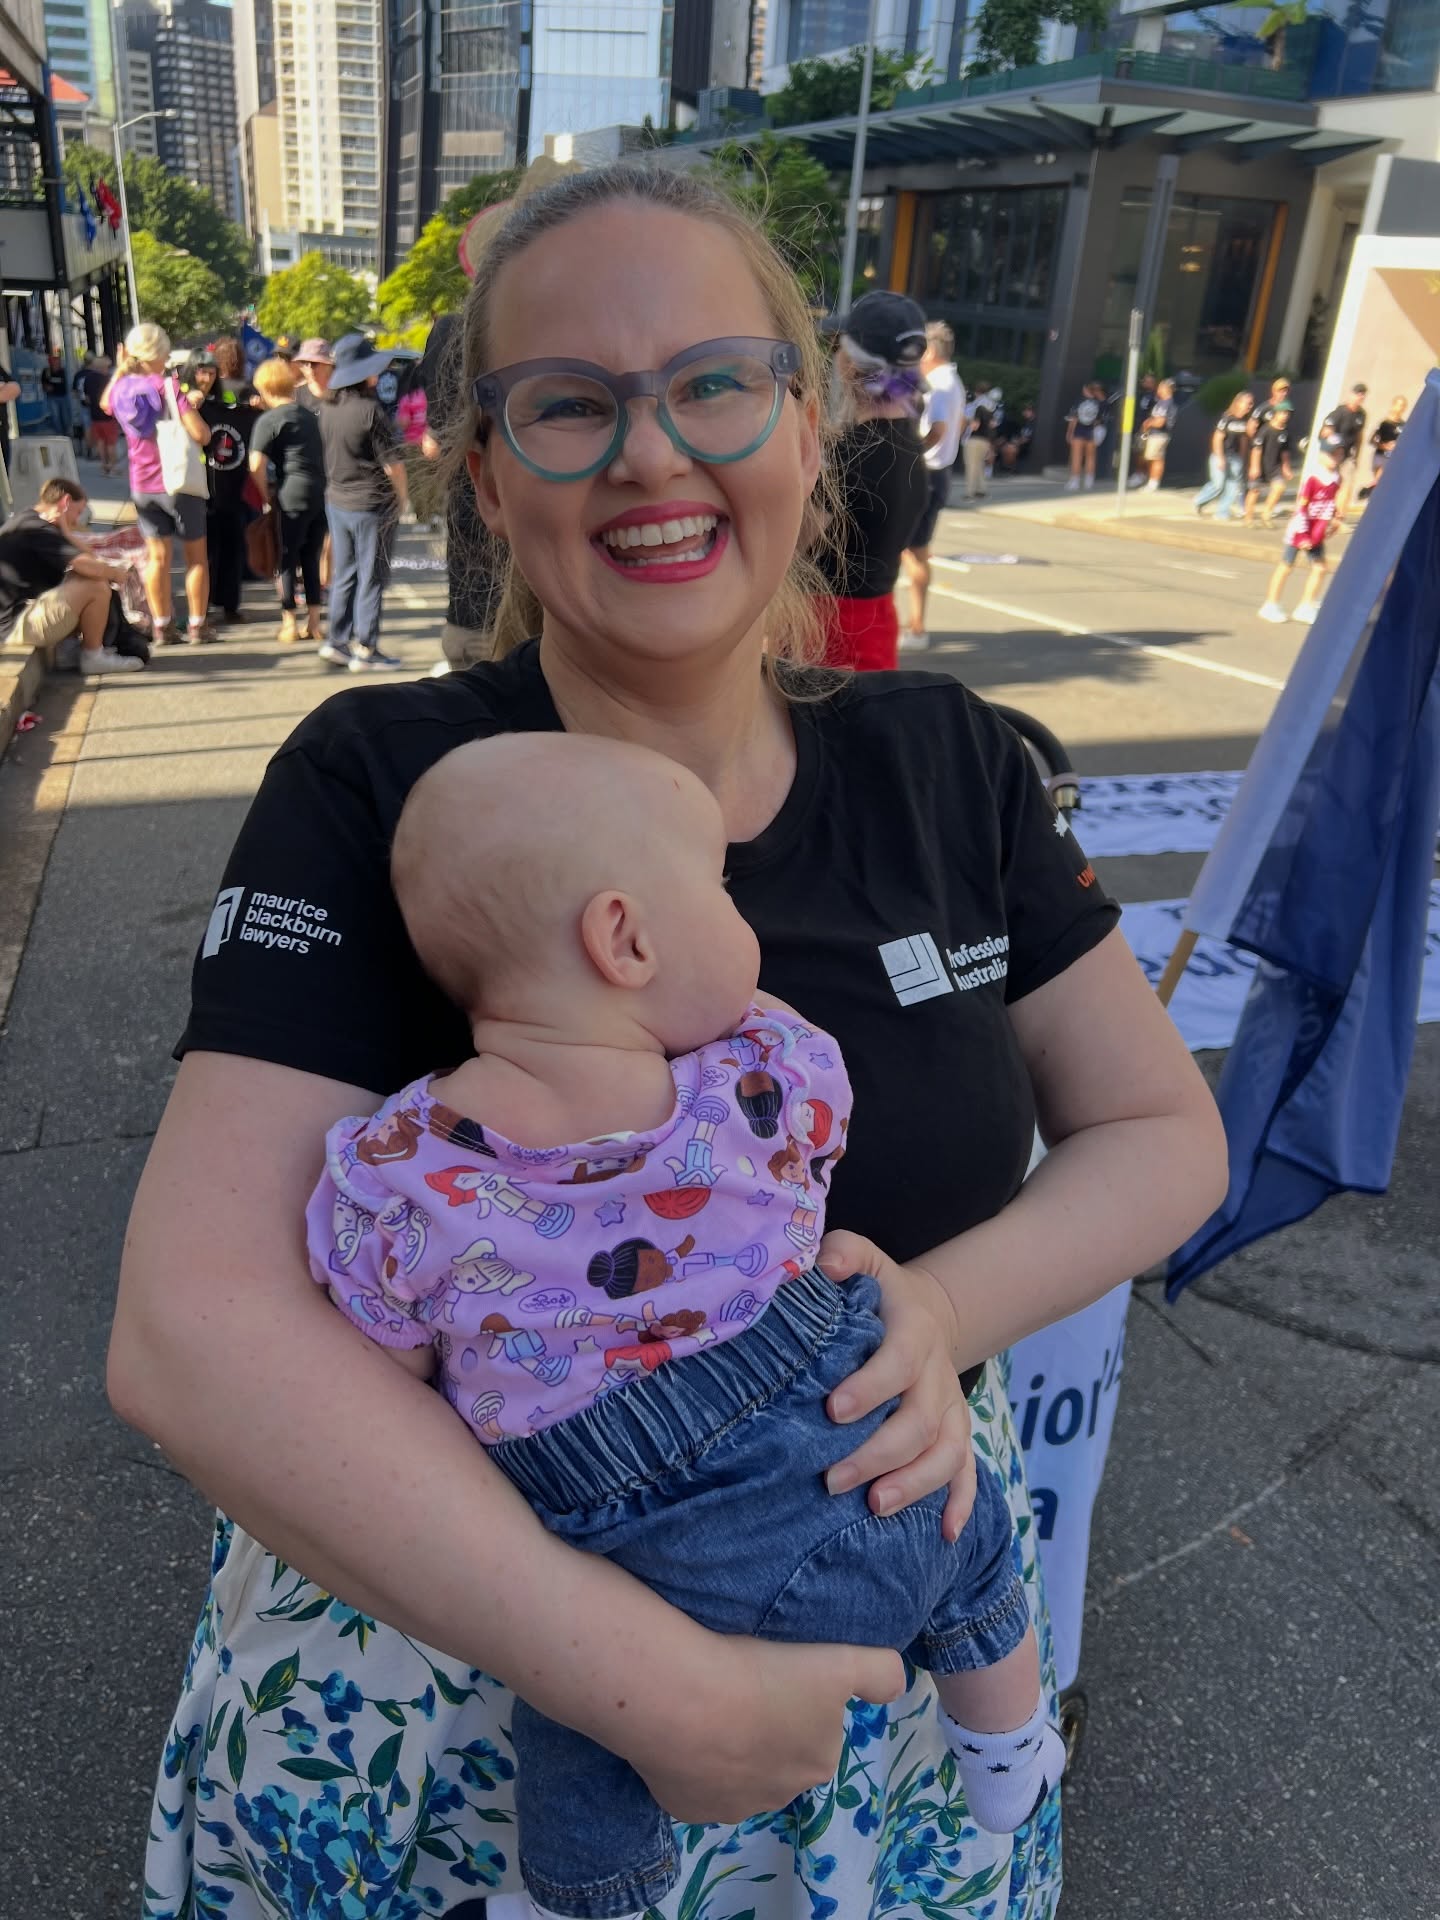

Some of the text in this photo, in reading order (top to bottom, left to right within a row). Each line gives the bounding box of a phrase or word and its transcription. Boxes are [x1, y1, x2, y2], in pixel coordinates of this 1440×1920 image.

[250, 892, 329, 922] maurice
[239, 923, 311, 954] lawyers
[244, 906, 343, 946] blackburn
